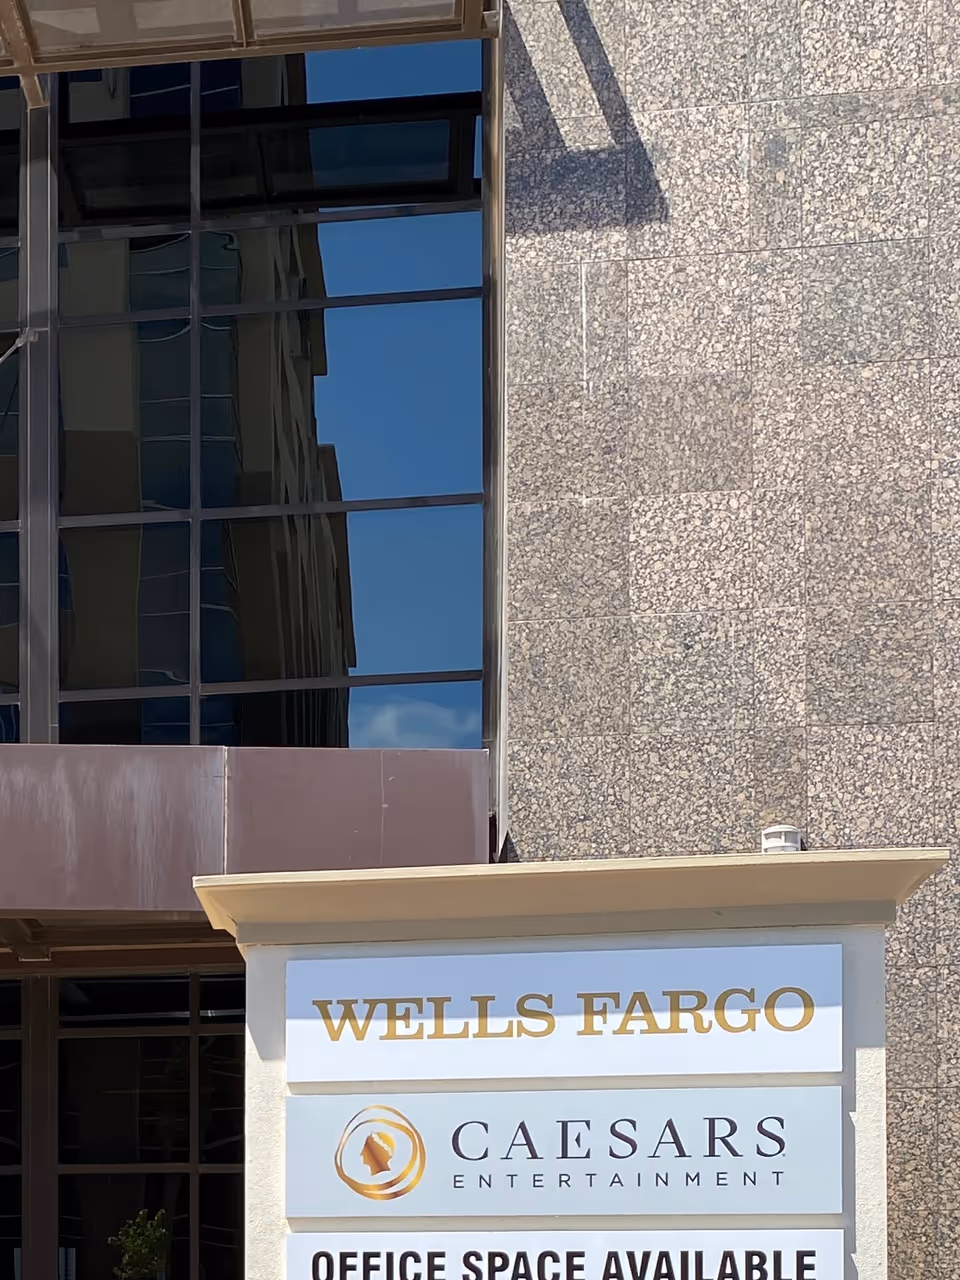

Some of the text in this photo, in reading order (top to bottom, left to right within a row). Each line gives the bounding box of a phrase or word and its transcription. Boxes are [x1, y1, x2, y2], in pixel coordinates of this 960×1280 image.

[312, 986, 815, 1042] WELLS FARGO
[451, 1116, 786, 1161] CAESARS
[453, 1171, 785, 1189] ENTERTAINMENT
